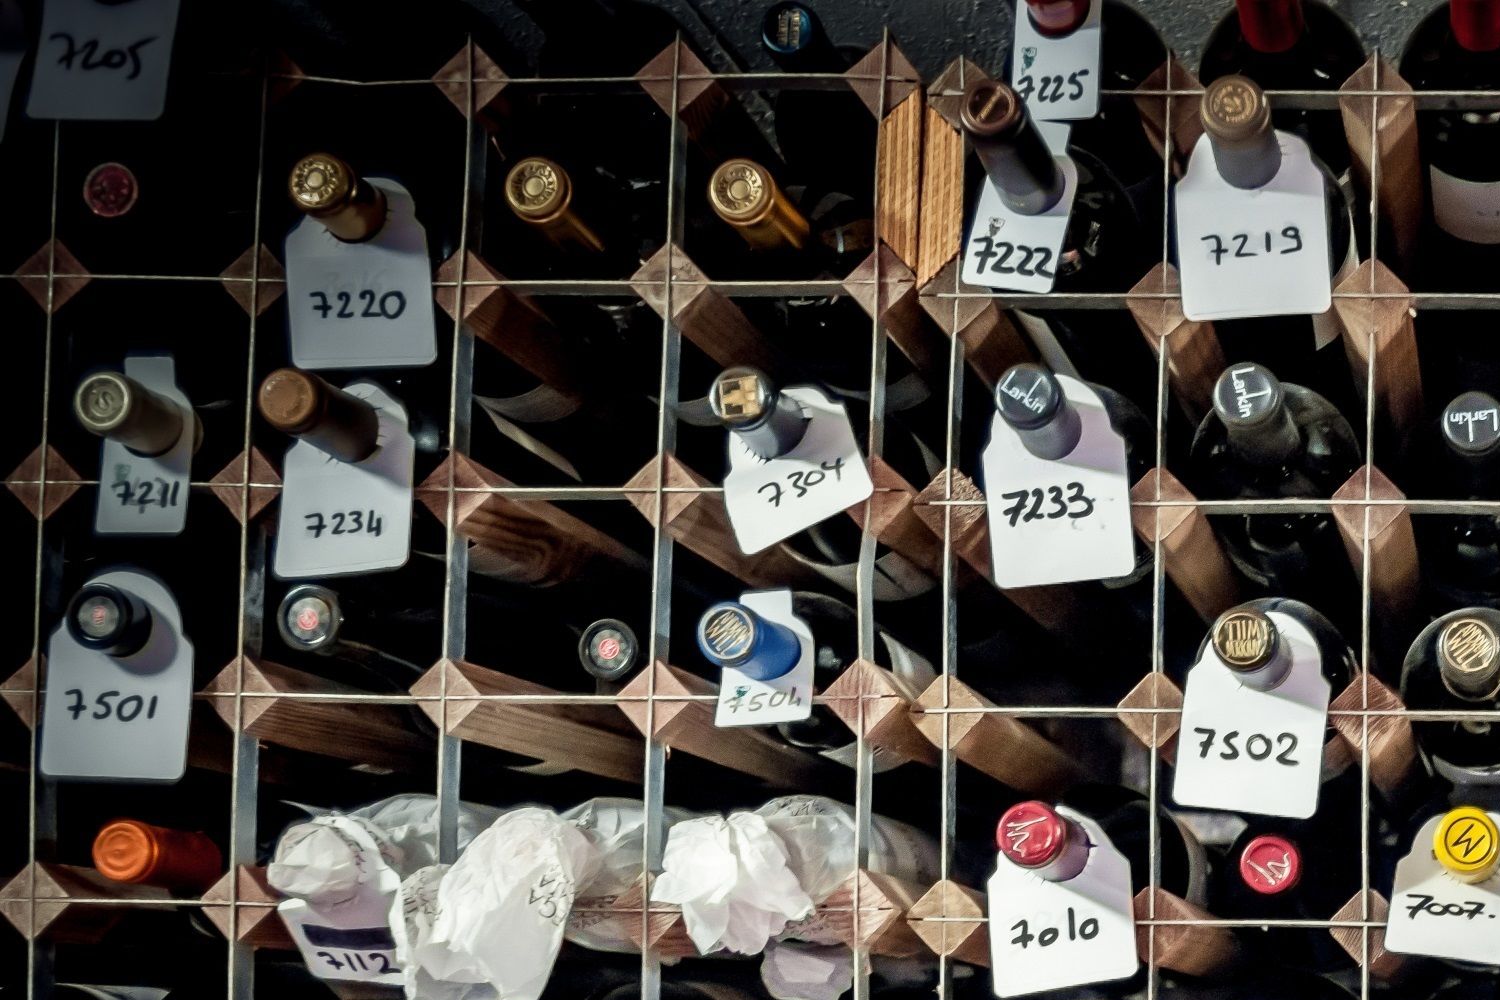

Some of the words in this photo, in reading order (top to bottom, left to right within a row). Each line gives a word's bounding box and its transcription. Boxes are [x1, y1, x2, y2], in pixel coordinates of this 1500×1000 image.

[49, 33, 157, 79] 7205
[1018, 69, 1090, 103] 7225
[972, 236, 1054, 278] 7222
[1201, 226, 1303, 266] 7219
[310, 290, 406, 320] 7220
[1001, 371, 1045, 413] Larkin
[1233, 367, 1271, 418] Larkin
[1449, 406, 1498, 441] Larkin
[112, 479, 179, 507] 7211
[759, 457, 845, 507] 7304
[1001, 481, 1096, 526] 7233
[306, 510, 382, 537] 7234
[66, 689, 156, 721] 7501
[725, 687, 801, 712] 7504
[1194, 727, 1299, 766] 7502
[1010, 908, 1100, 947] 7010
[317, 951, 400, 974] 7112
